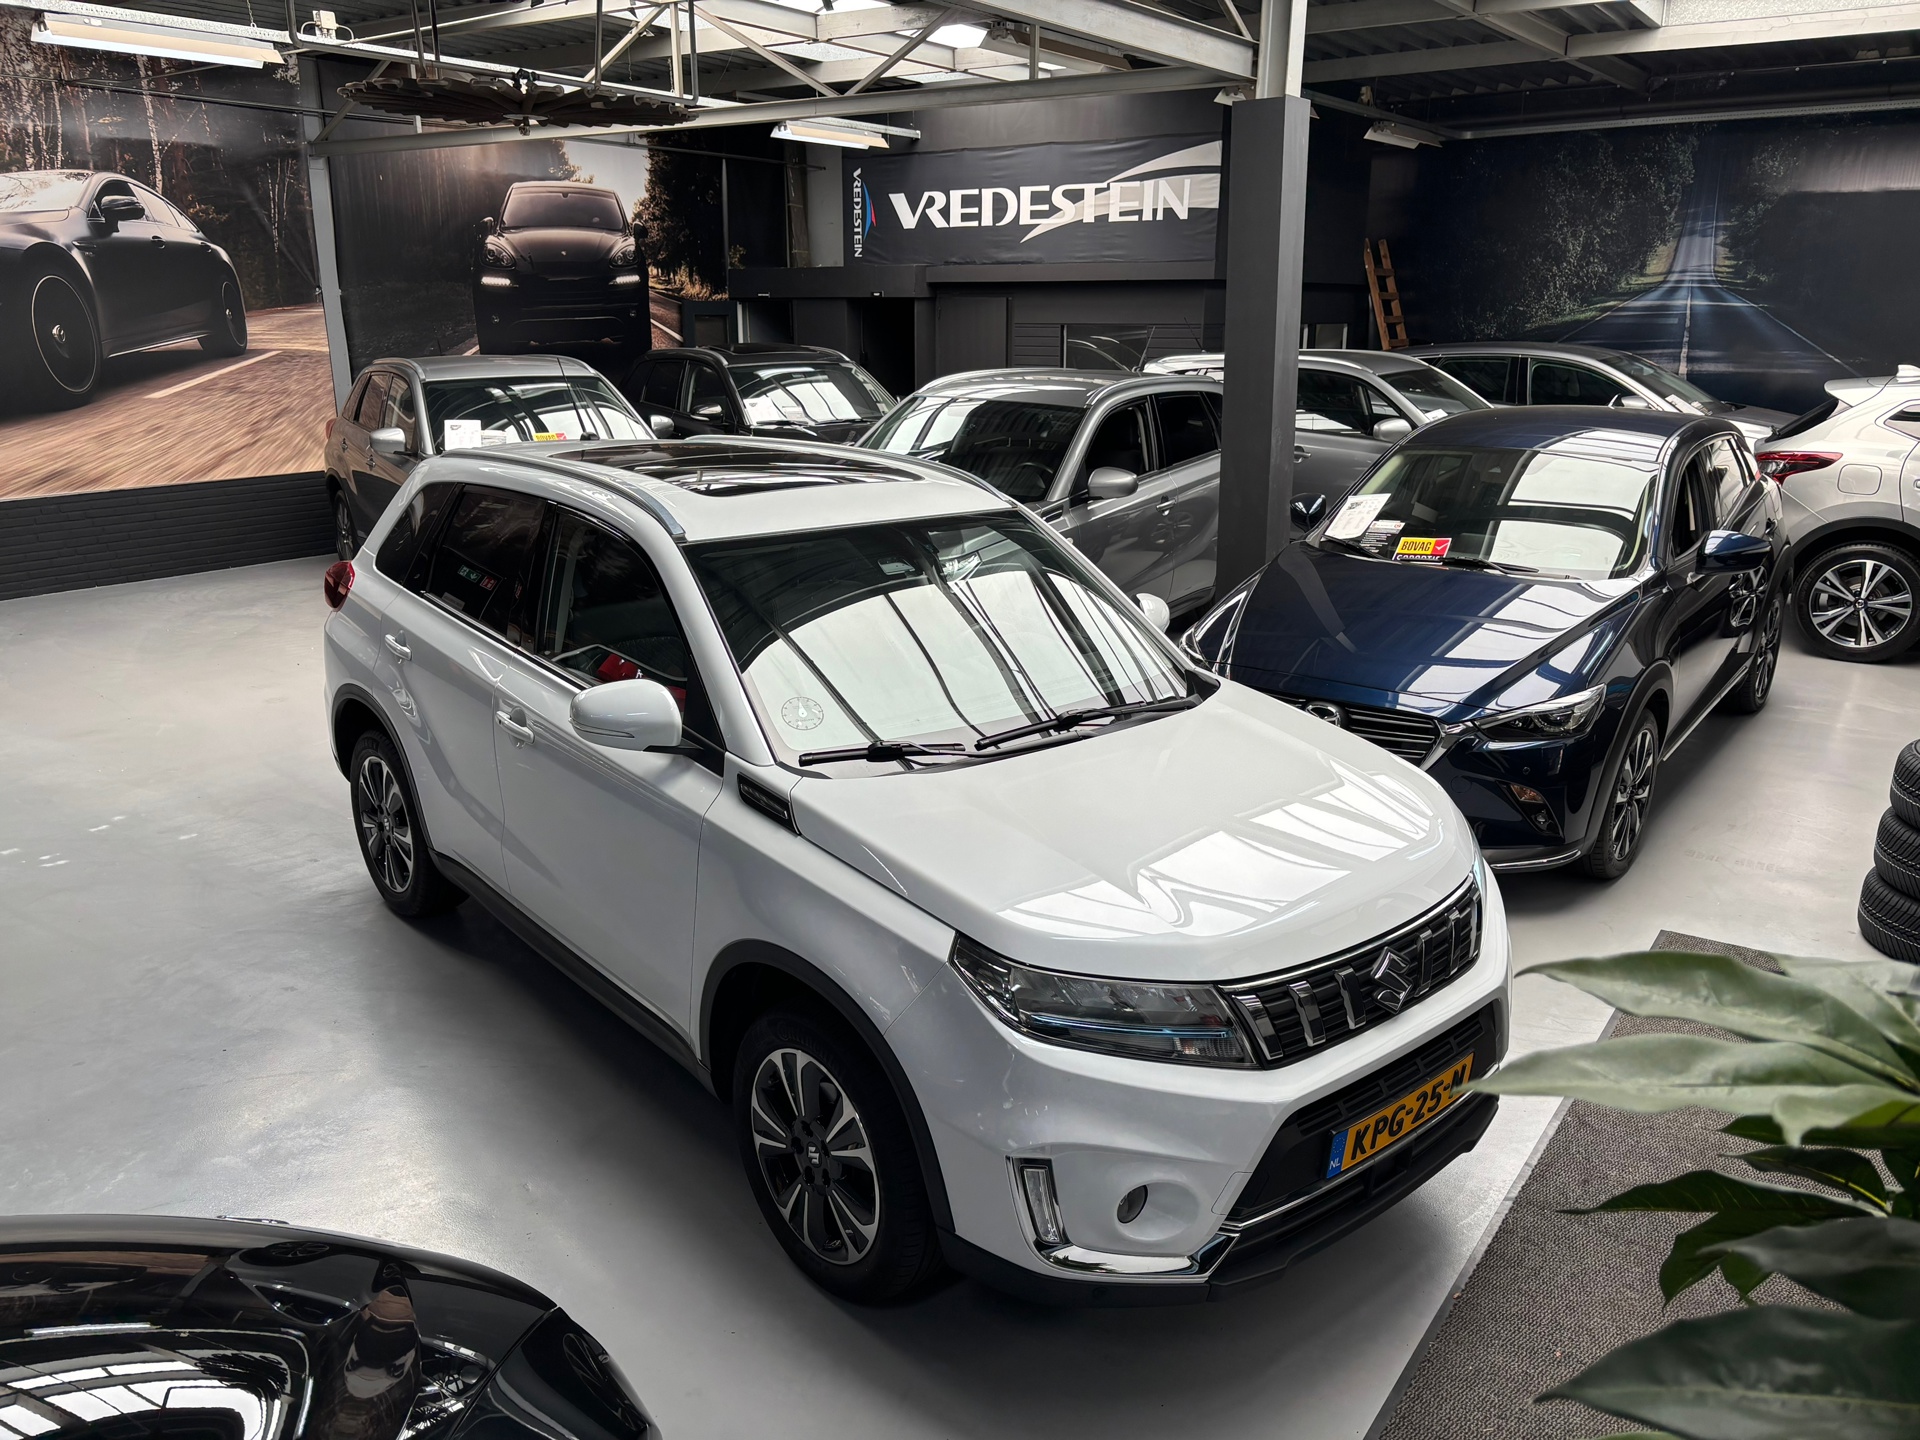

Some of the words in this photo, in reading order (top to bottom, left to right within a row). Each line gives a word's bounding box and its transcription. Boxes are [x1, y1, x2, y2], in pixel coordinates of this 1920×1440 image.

[853, 167, 863, 258] VREDESTEIN
[888, 178, 1191, 230] VREDESTEIN
[1401, 540, 1432, 551] BOVAG
[1350, 1063, 1468, 1161] KPG-25-N
[1329, 1157, 1341, 1170] NL
